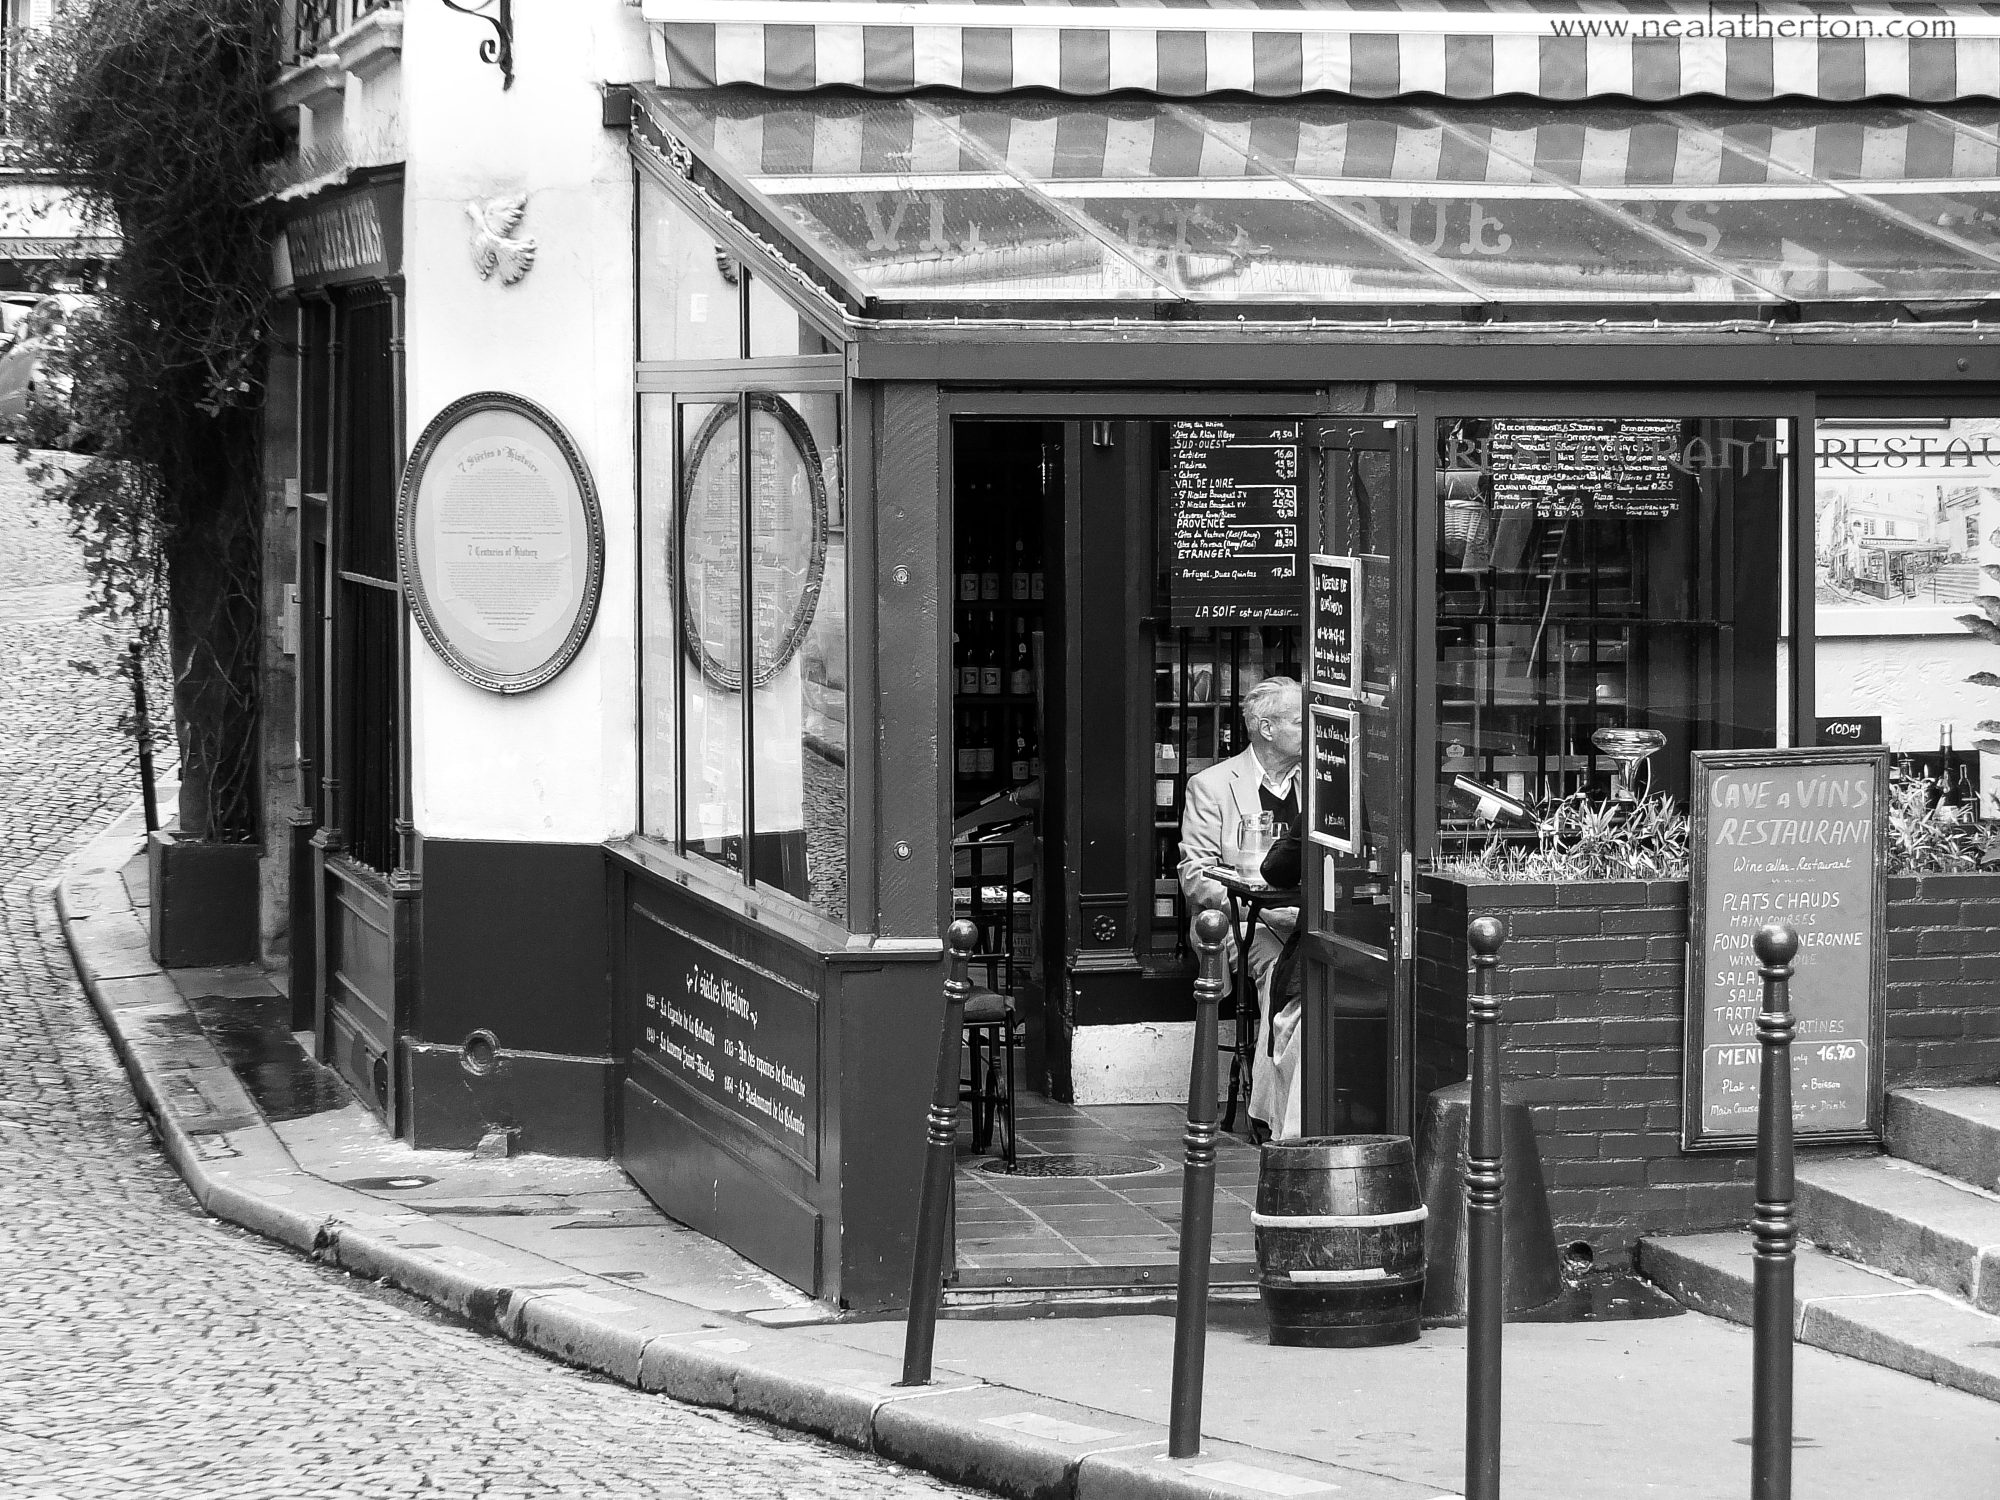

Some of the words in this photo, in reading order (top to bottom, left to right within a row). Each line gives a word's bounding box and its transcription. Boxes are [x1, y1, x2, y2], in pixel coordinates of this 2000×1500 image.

[1175, 478, 1193, 488] VAL
[1197, 478, 1208, 488] DE
[1210, 478, 1234, 488] LOIRE
[1176, 519, 1225, 528] PROVENCE
[467, 544, 473, 557] 7
[475, 546, 504, 557] Centuries
[505, 547, 512, 557] of
[512, 545, 539, 560] History
[1178, 549, 1232, 559] ETRANGER
[1195, 605, 1209, 617] LA
[1212, 605, 1237, 617] SOIF
[1239, 607, 1253, 617] est
[1825, 722, 1862, 738] TODAY
[1711, 774, 1775, 809] CAVE
[1715, 818, 1872, 845] RESTAURANT
[1733, 856, 1762, 873] Wine
[1722, 892, 1769, 912] PLATS
[1774, 891, 1840, 910] CHAUDS
[1767, 913, 1816, 927] COURSES
